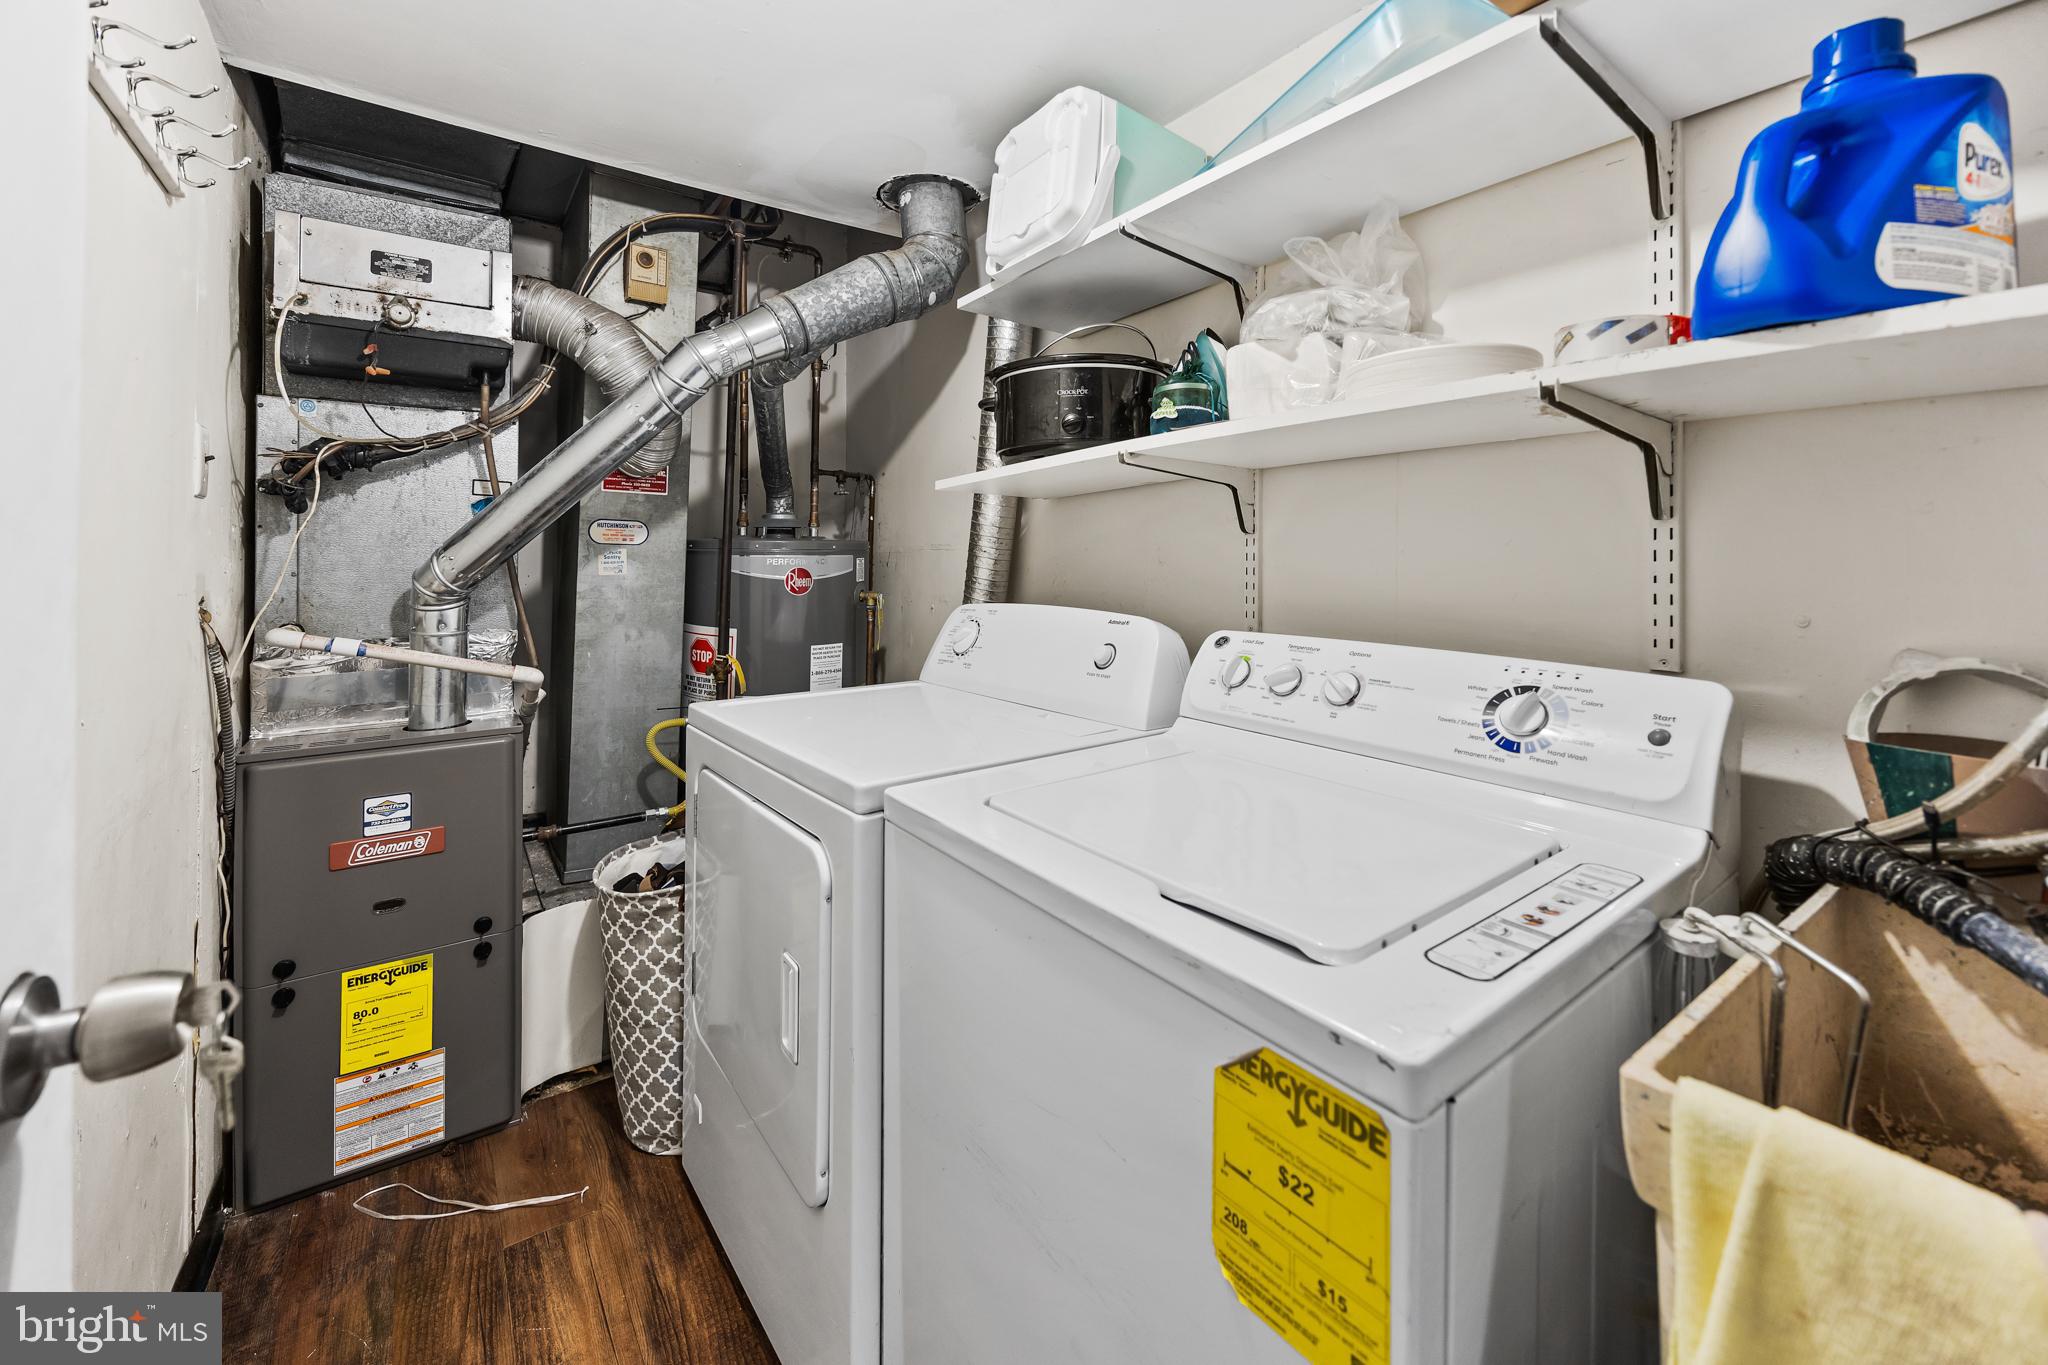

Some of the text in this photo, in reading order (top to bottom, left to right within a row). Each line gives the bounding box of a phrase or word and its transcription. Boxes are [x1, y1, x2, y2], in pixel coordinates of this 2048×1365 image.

[1965, 142, 2003, 177] Purex
[788, 568, 812, 591] Rheem
[1287, 643, 1321, 653] Temperature
[1349, 650, 1372, 659] Options
[691, 649, 713, 663] STOP
[1552, 683, 1595, 695] Speed Wash
[1581, 699, 1604, 709] Colors
[1437, 715, 1457, 725] Towels
[1652, 713, 1677, 723] Start
[1468, 734, 1486, 742] Jeans
[1454, 747, 1506, 764] Permanent Press
[1529, 755, 1559, 767] Prewash
[1547, 749, 1588, 762] Hand Wash
[356, 840, 413, 859] Coleman
[346, 961, 428, 987] ENERGYGUIDE
[353, 1007, 379, 1020] 80.0
[1278, 1164, 1315, 1208] $22
[1223, 1205, 1248, 1236] 208
[1317, 1279, 1349, 1314] $15
